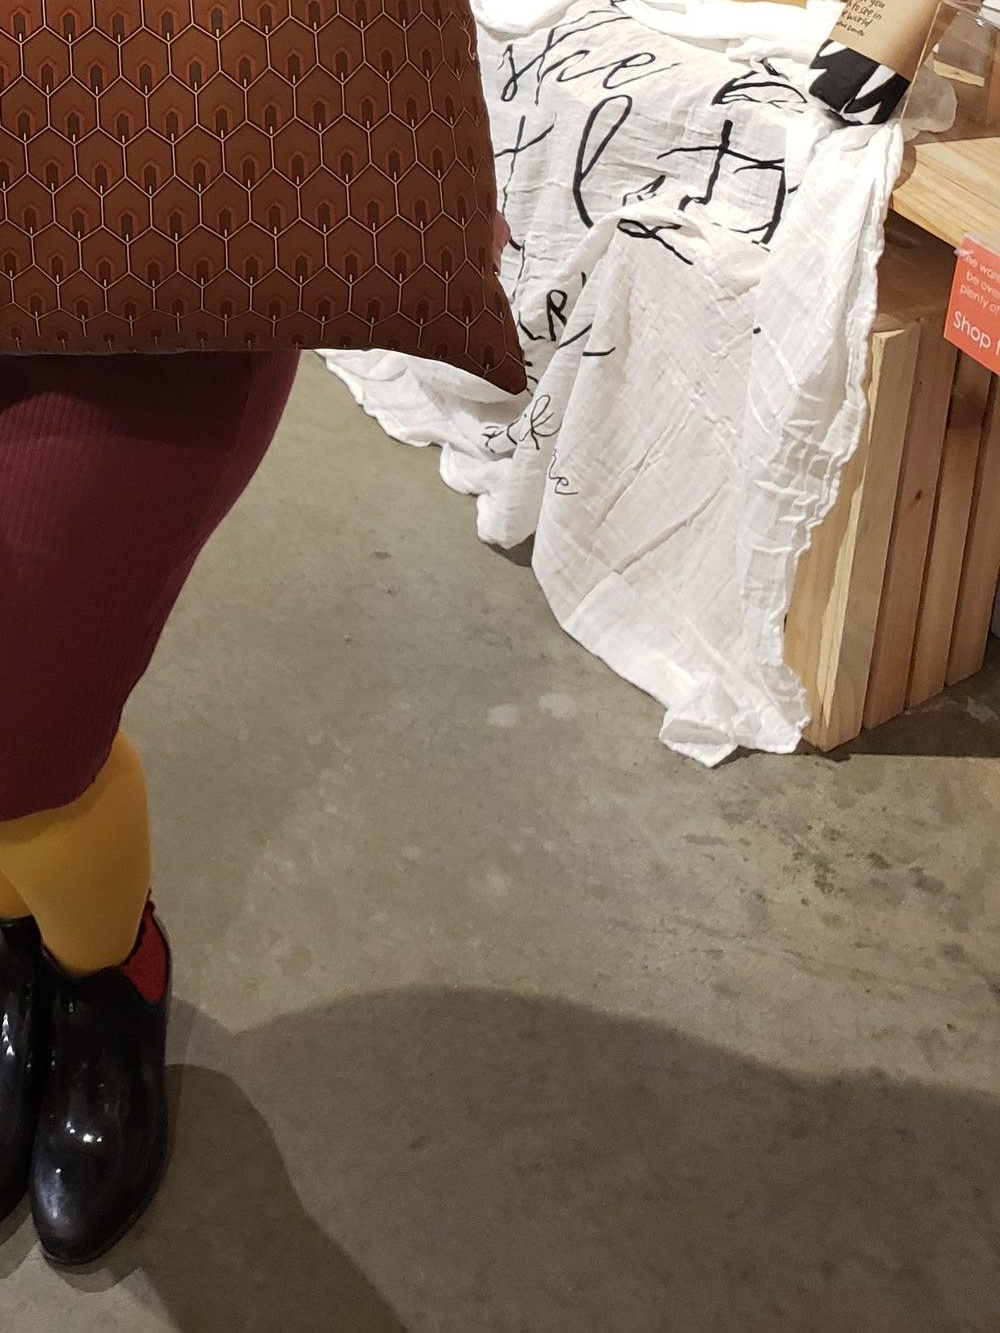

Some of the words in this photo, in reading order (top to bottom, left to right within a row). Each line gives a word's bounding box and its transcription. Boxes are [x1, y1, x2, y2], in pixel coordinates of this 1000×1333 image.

[962, 253, 978, 268] he
[966, 270, 979, 285] be
[960, 283, 989, 309] plenty
[953, 309, 992, 350] Shop
